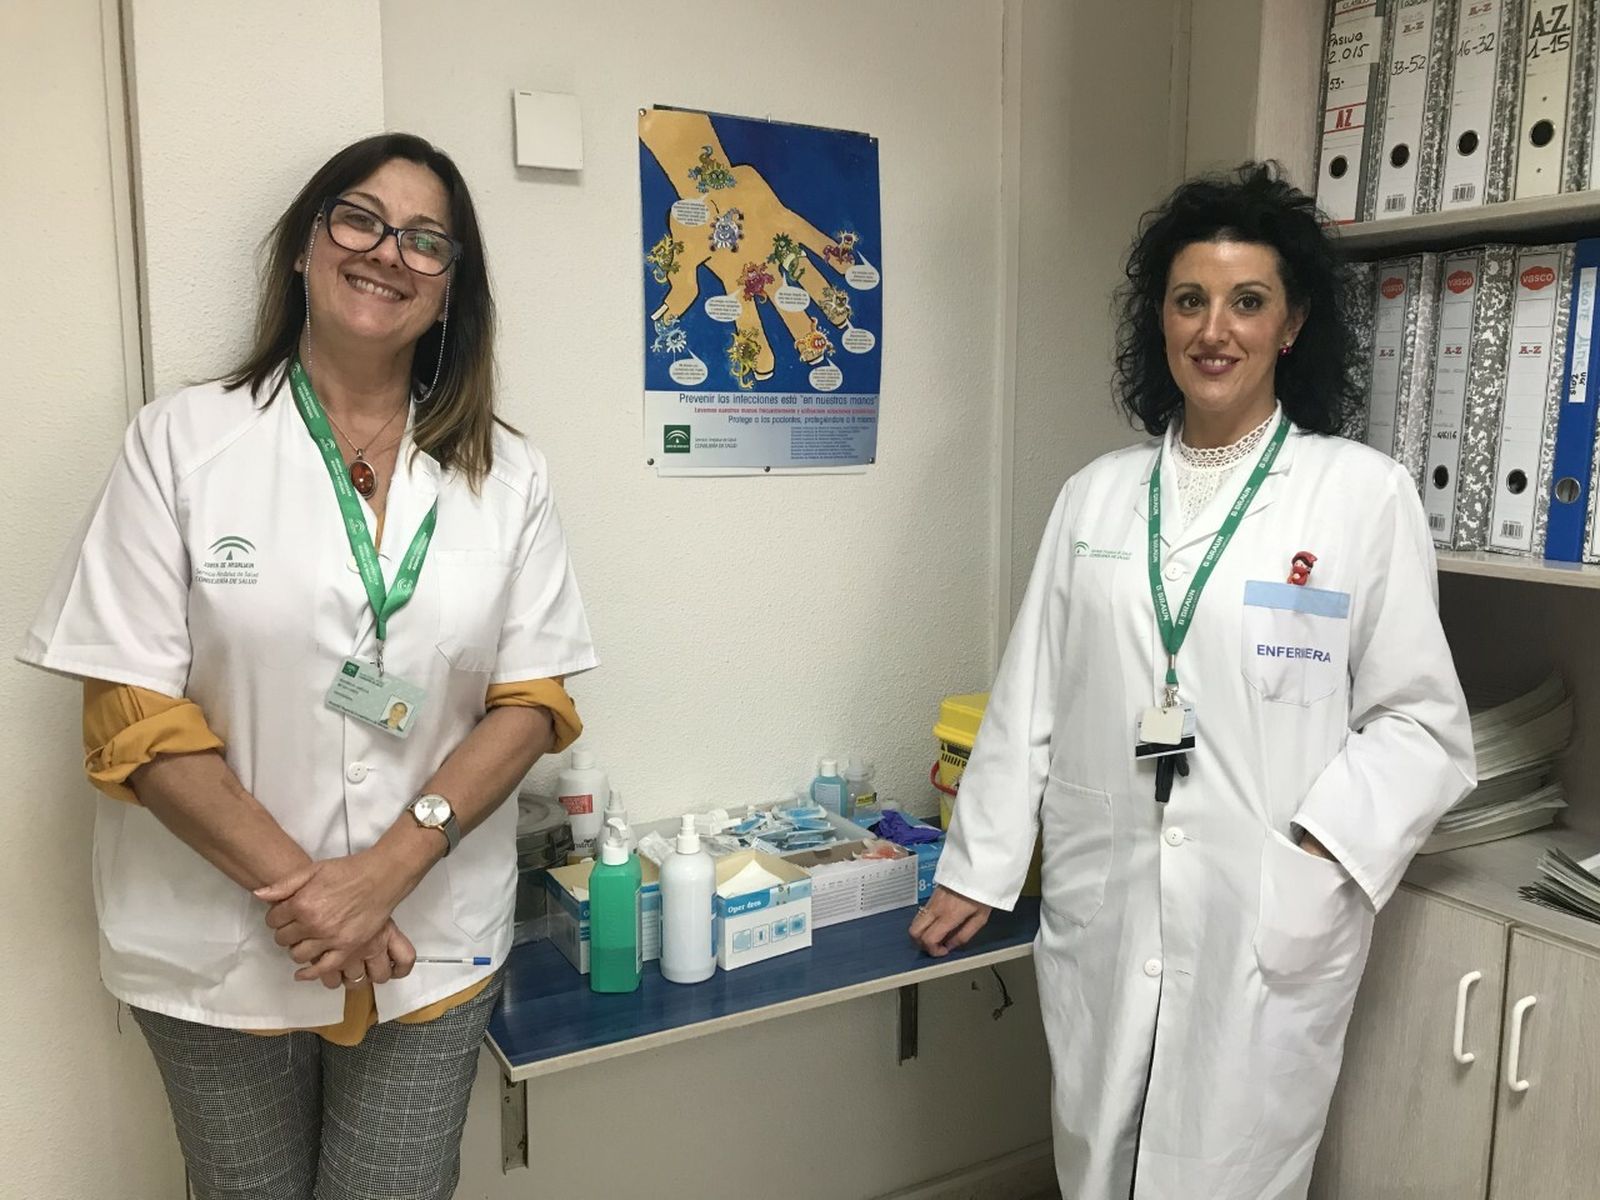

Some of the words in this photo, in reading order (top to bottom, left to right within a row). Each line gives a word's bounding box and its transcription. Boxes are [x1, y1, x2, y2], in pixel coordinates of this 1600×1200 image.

[1327, 43, 1370, 65] 2.015
[1457, 32, 1495, 57] 16-32
[1526, 34, 1571, 59] 1-15
[1391, 54, 1427, 76] 33-52
[1335, 108, 1353, 128] AZ
[1444, 346, 1462, 355] A-Z
[1519, 345, 1542, 355] A-Z
[679, 393, 715, 404] Prevenir
[717, 394, 730, 404] las
[733, 394, 779, 405] infecciones
[781, 394, 797, 405] está
[816, 395, 847, 405] nuestras
[728, 415, 753, 425] Protege
[1235, 487, 1252, 510] BRAUN
[1206, 536, 1224, 560] BRAUN
[1157, 592, 1169, 621] BRAUN
[1182, 589, 1196, 617] BRAUN
